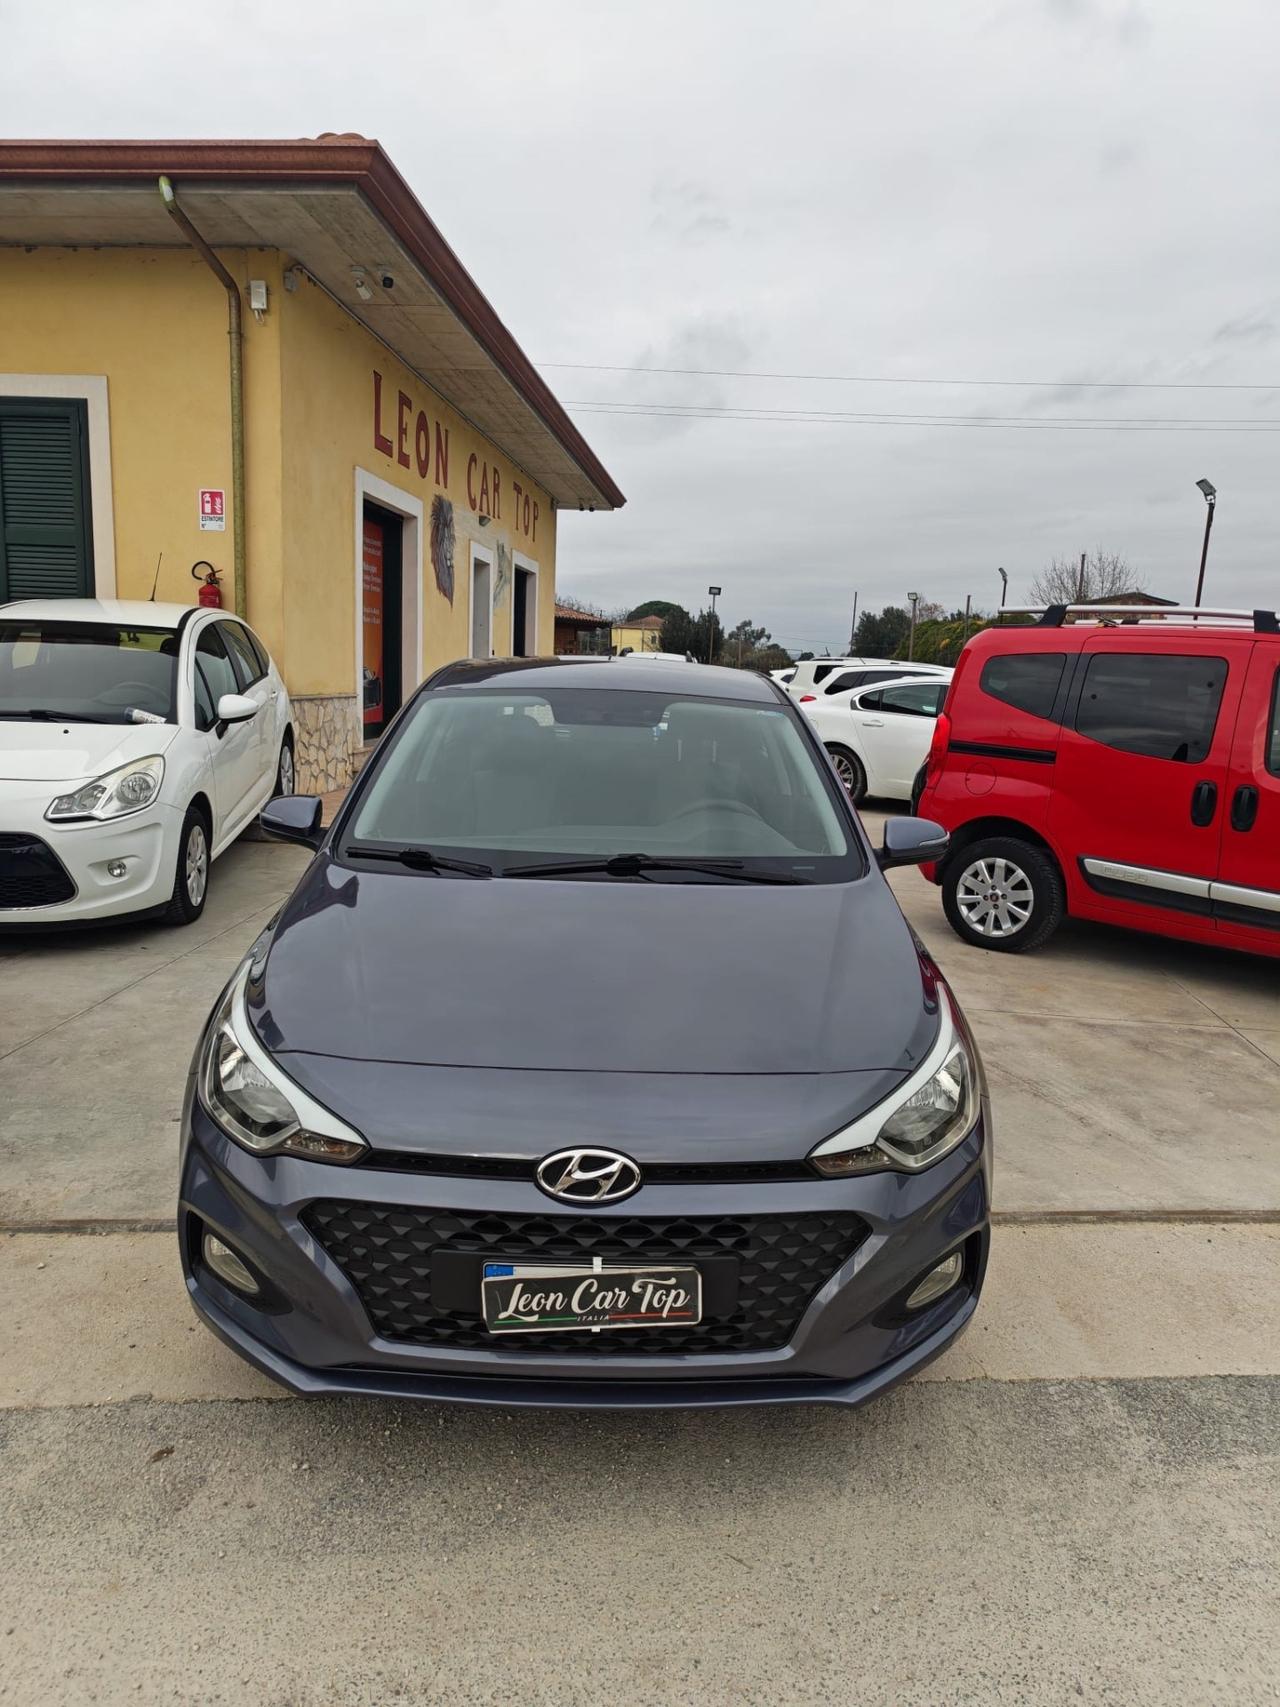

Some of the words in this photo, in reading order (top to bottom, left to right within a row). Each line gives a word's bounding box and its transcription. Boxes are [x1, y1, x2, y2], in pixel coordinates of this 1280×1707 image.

[373, 370, 448, 489] LEON
[467, 452, 501, 520] CAR
[513, 481, 539, 543] TOP
[498, 1283, 567, 1321] Leon
[571, 1278, 630, 1314] Car
[632, 1277, 691, 1318] Top
